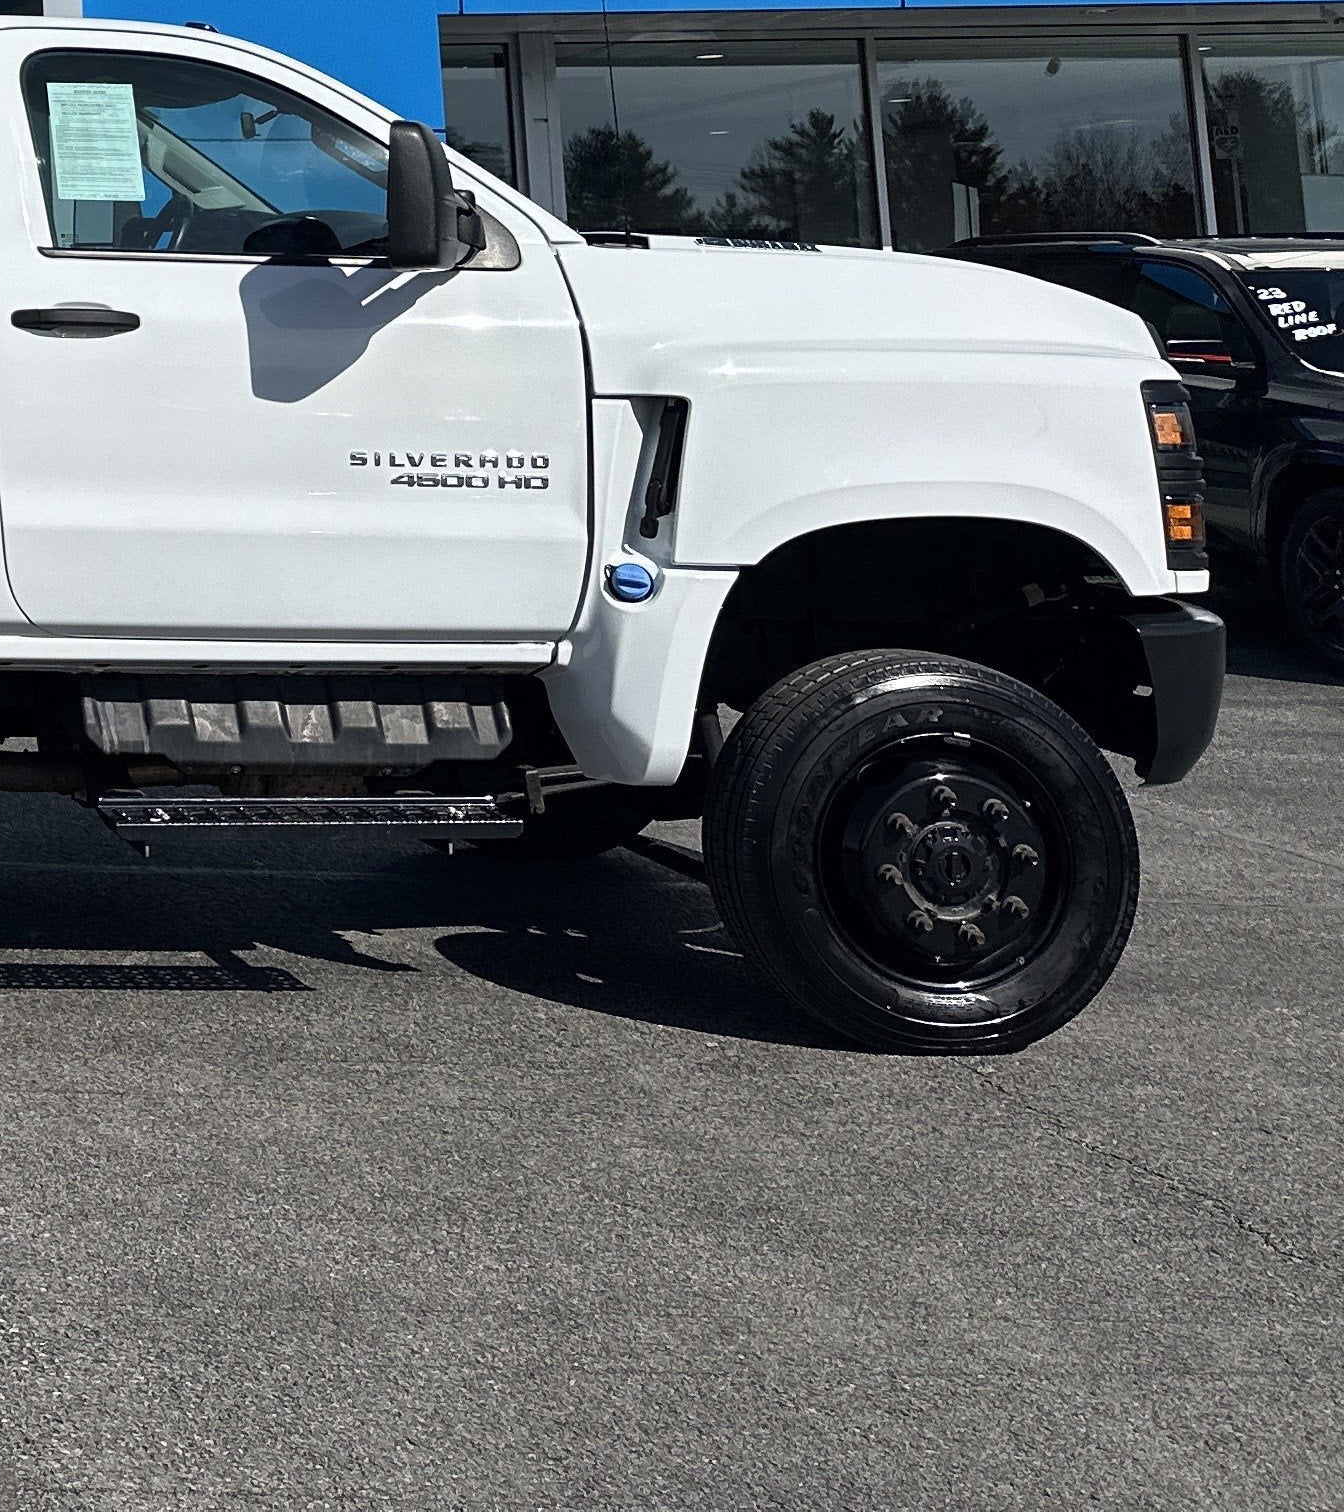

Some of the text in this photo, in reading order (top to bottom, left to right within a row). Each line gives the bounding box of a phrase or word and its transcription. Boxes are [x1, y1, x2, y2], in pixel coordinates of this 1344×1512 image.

[1268, 300, 1306, 317] RED
[1278, 310, 1319, 329] LINE
[1292, 323, 1337, 341] ROOF
[349, 450, 550, 469] SILVERADO
[390, 471, 550, 489] 4500 HD
